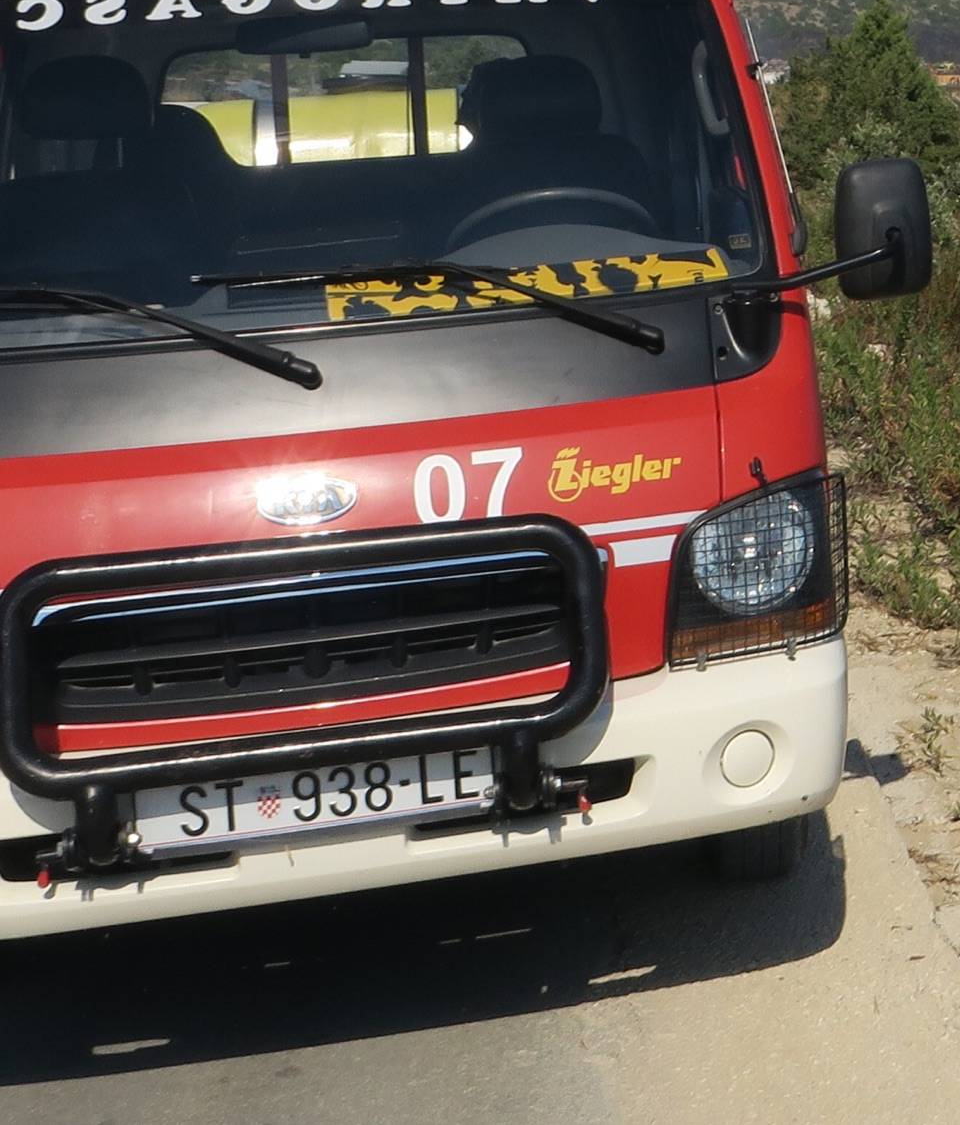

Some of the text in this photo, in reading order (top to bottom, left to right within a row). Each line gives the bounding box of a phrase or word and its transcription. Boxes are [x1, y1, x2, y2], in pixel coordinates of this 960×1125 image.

[413, 446, 523, 524] 07
[548, 447, 681, 502] Ziegler
[179, 750, 479, 837] ST 938-LE
